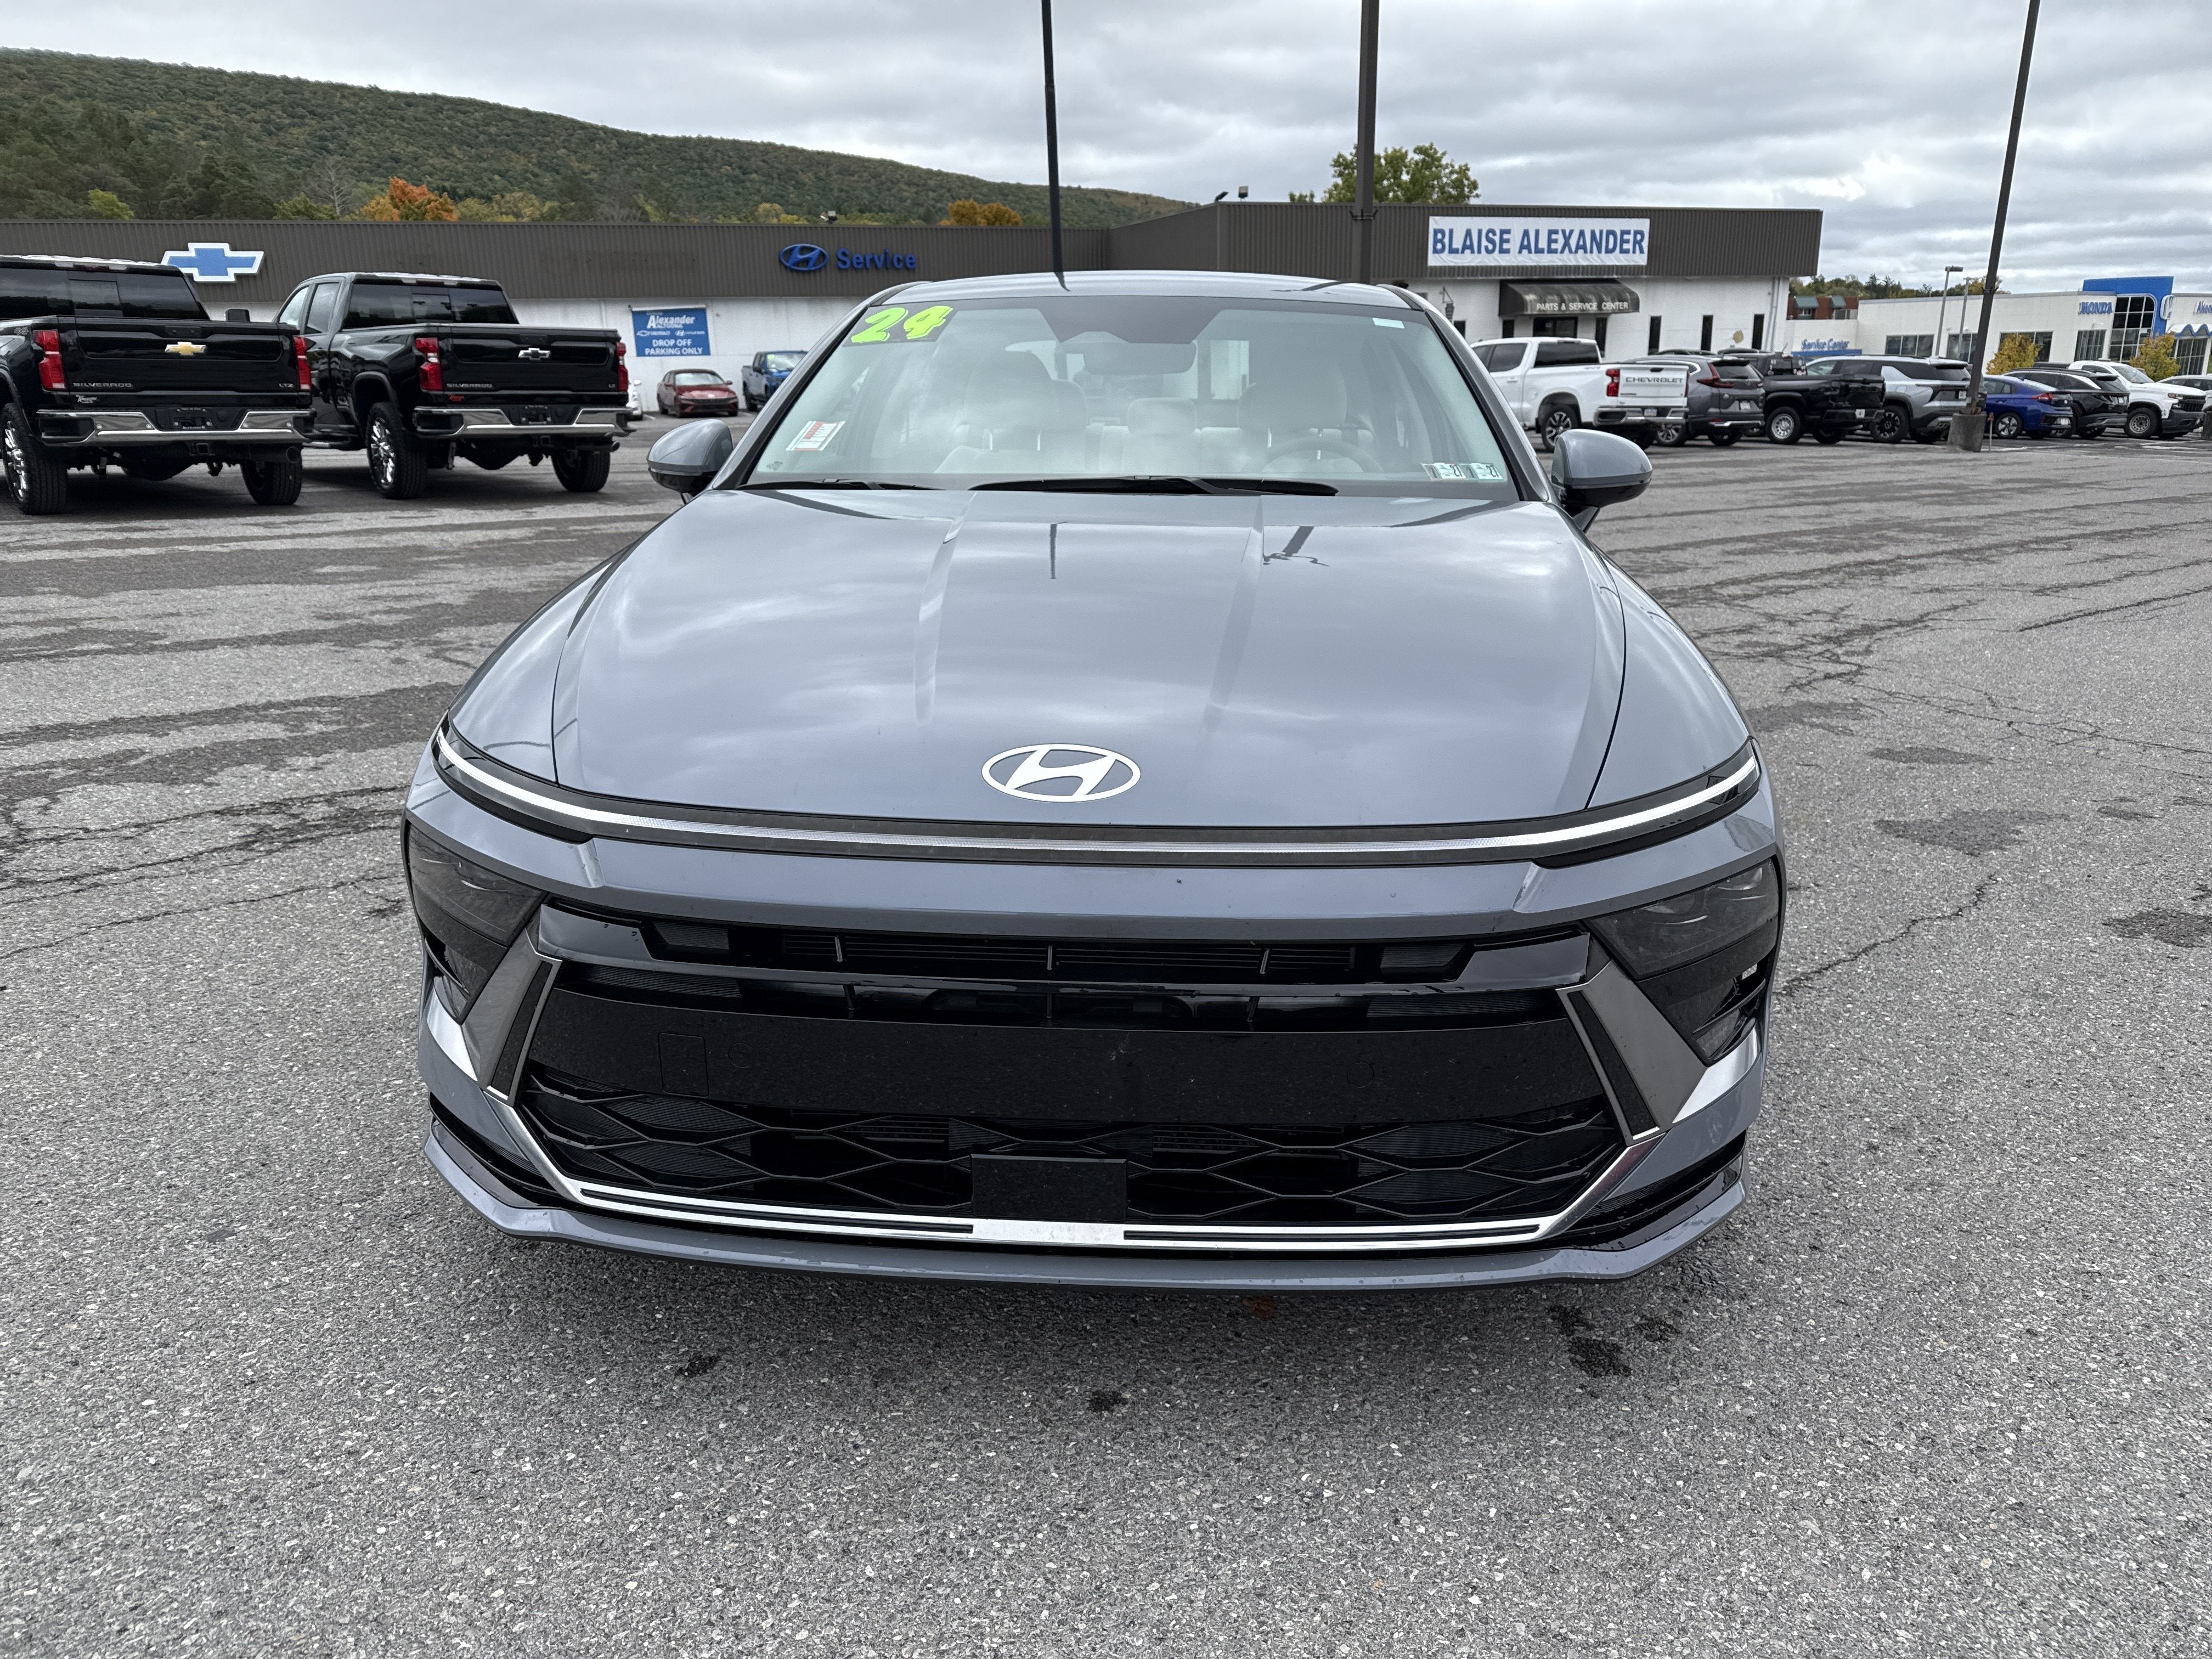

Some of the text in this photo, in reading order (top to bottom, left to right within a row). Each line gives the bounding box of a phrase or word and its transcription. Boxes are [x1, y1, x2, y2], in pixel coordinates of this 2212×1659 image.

[1432, 228, 1645, 255] BLAISE ALEXANDER
[837, 248, 917, 269] Service
[1536, 303, 1559, 311] PARTS
[1568, 302, 1598, 311] SERVICE
[1601, 302, 1628, 310] CENTER
[2080, 302, 2113, 314] HONDA
[647, 314, 695, 329] Alexander
[851, 306, 953, 343] 24
